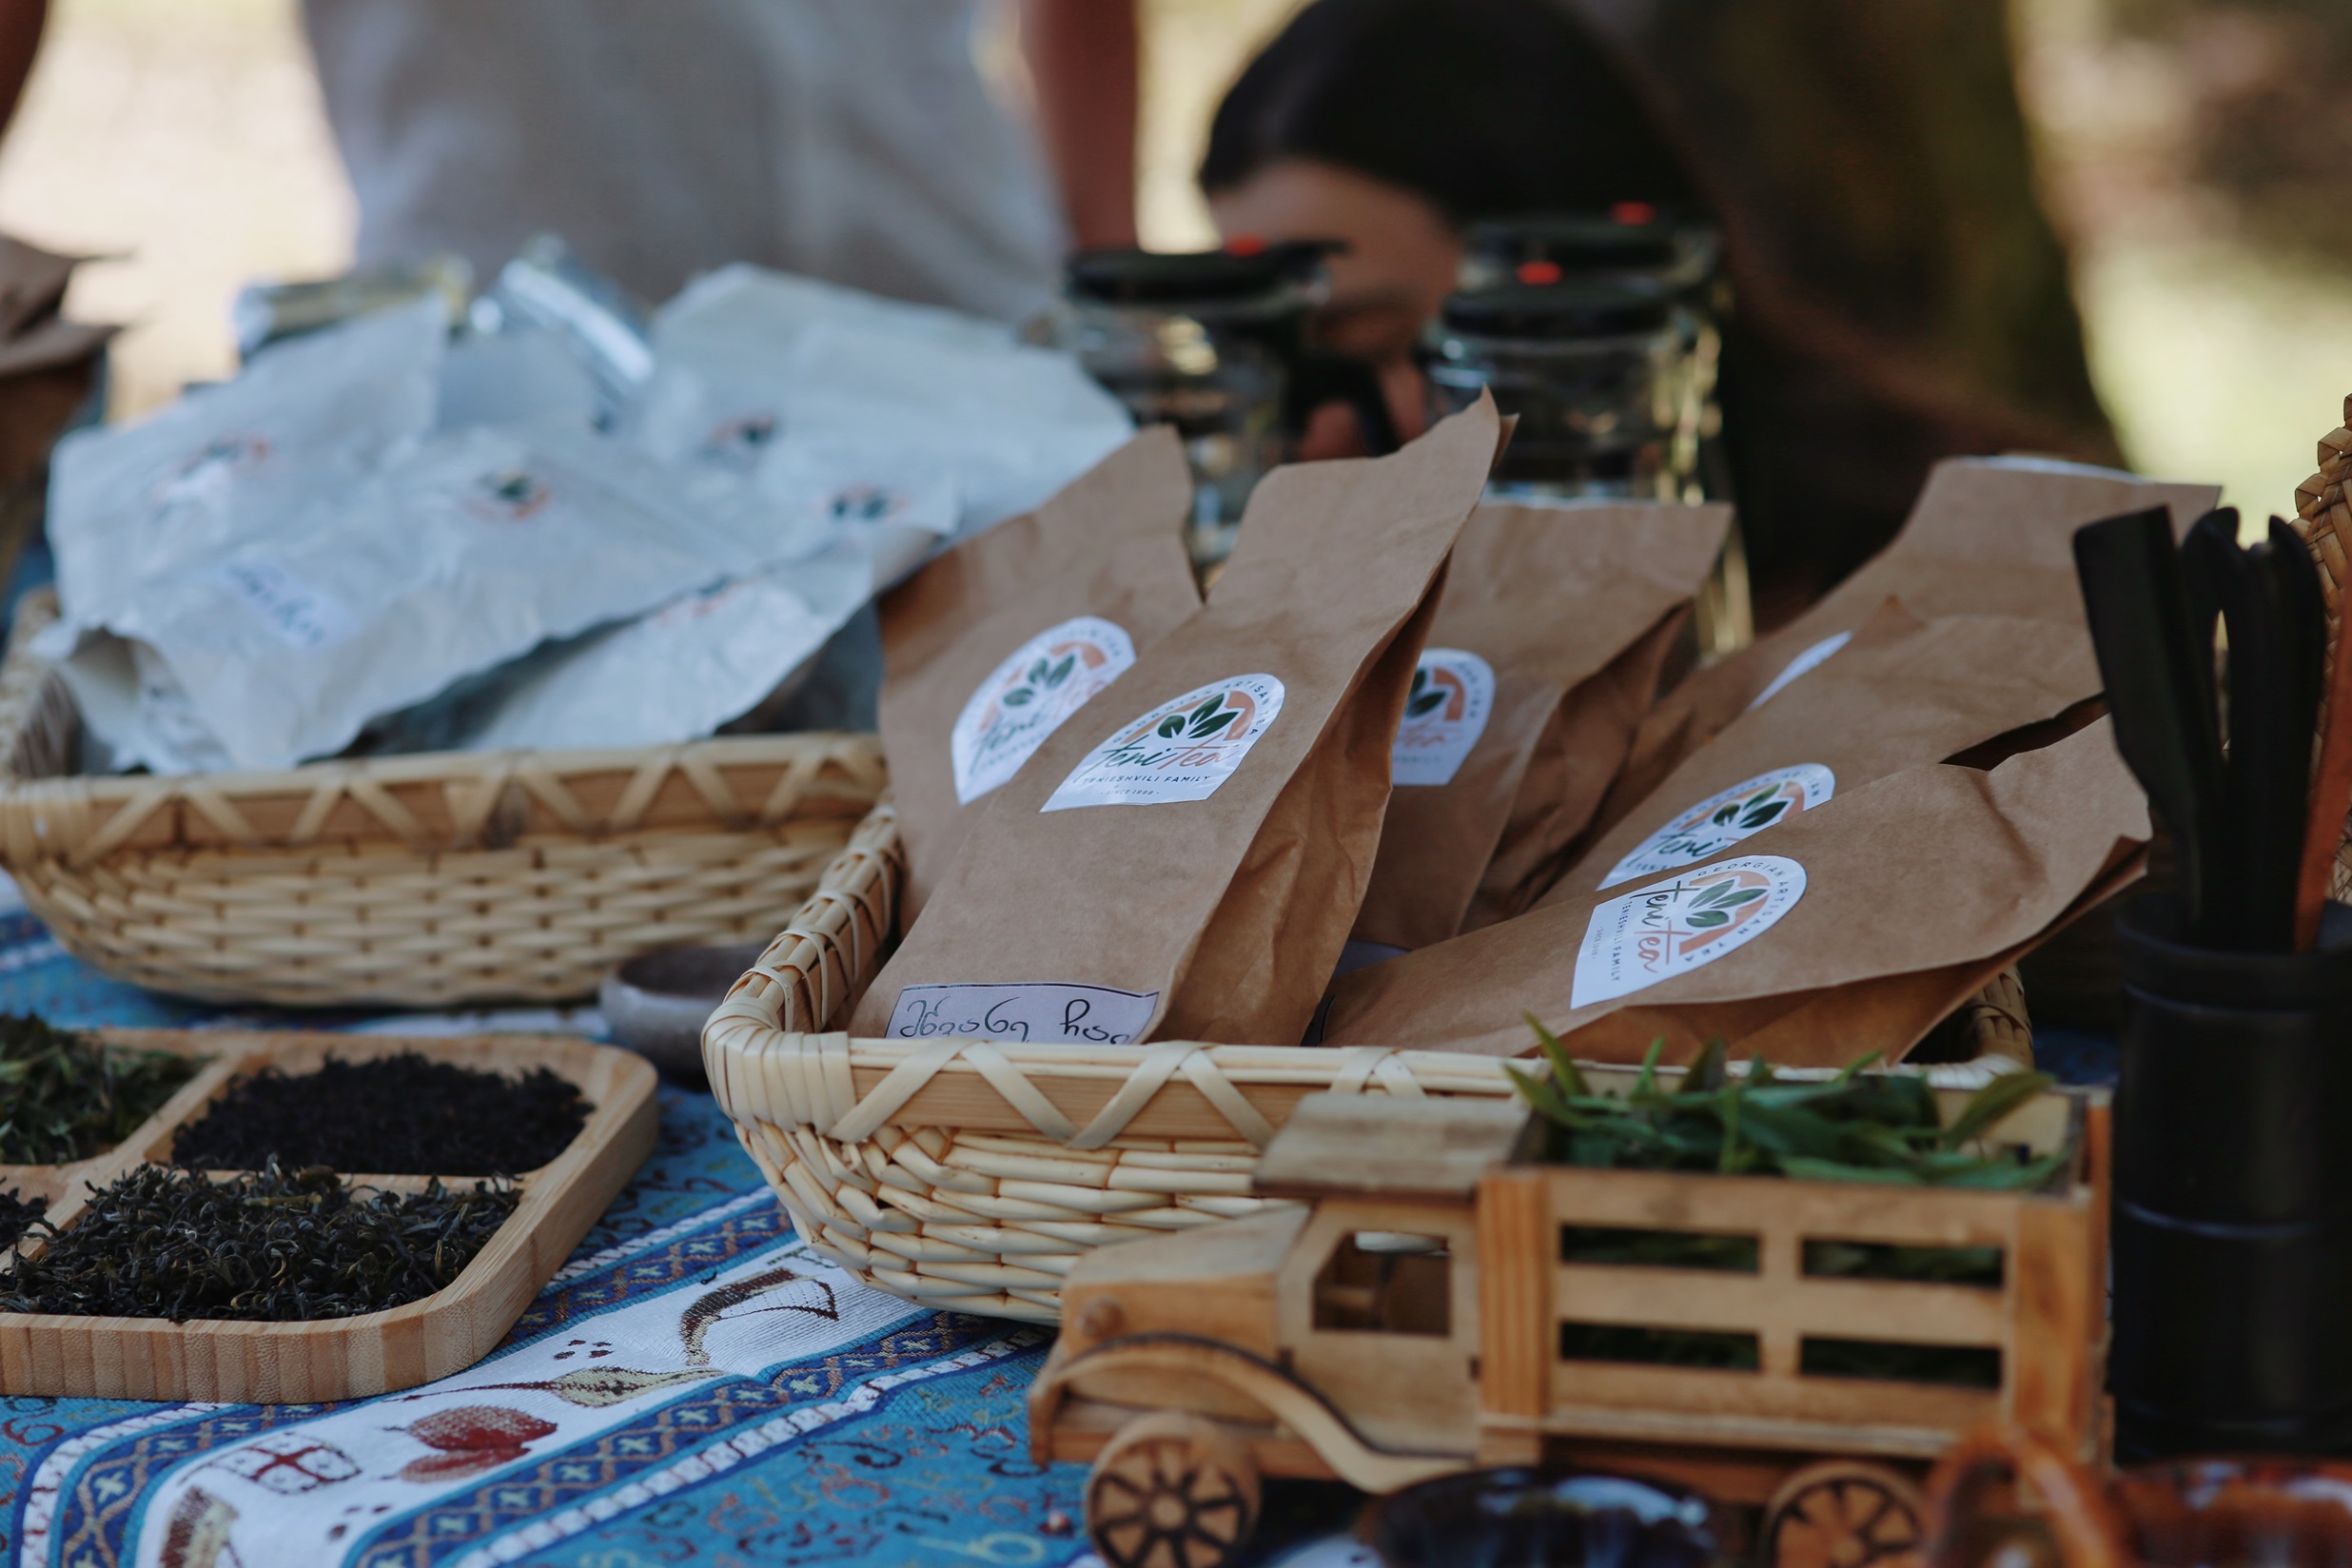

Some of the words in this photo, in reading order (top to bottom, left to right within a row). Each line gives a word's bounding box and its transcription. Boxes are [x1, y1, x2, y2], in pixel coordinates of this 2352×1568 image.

[1248, 710, 1269, 735] TEA
[1697, 861, 1786, 876] GEORGIAN
[1611, 946, 1622, 981] FAMILY
